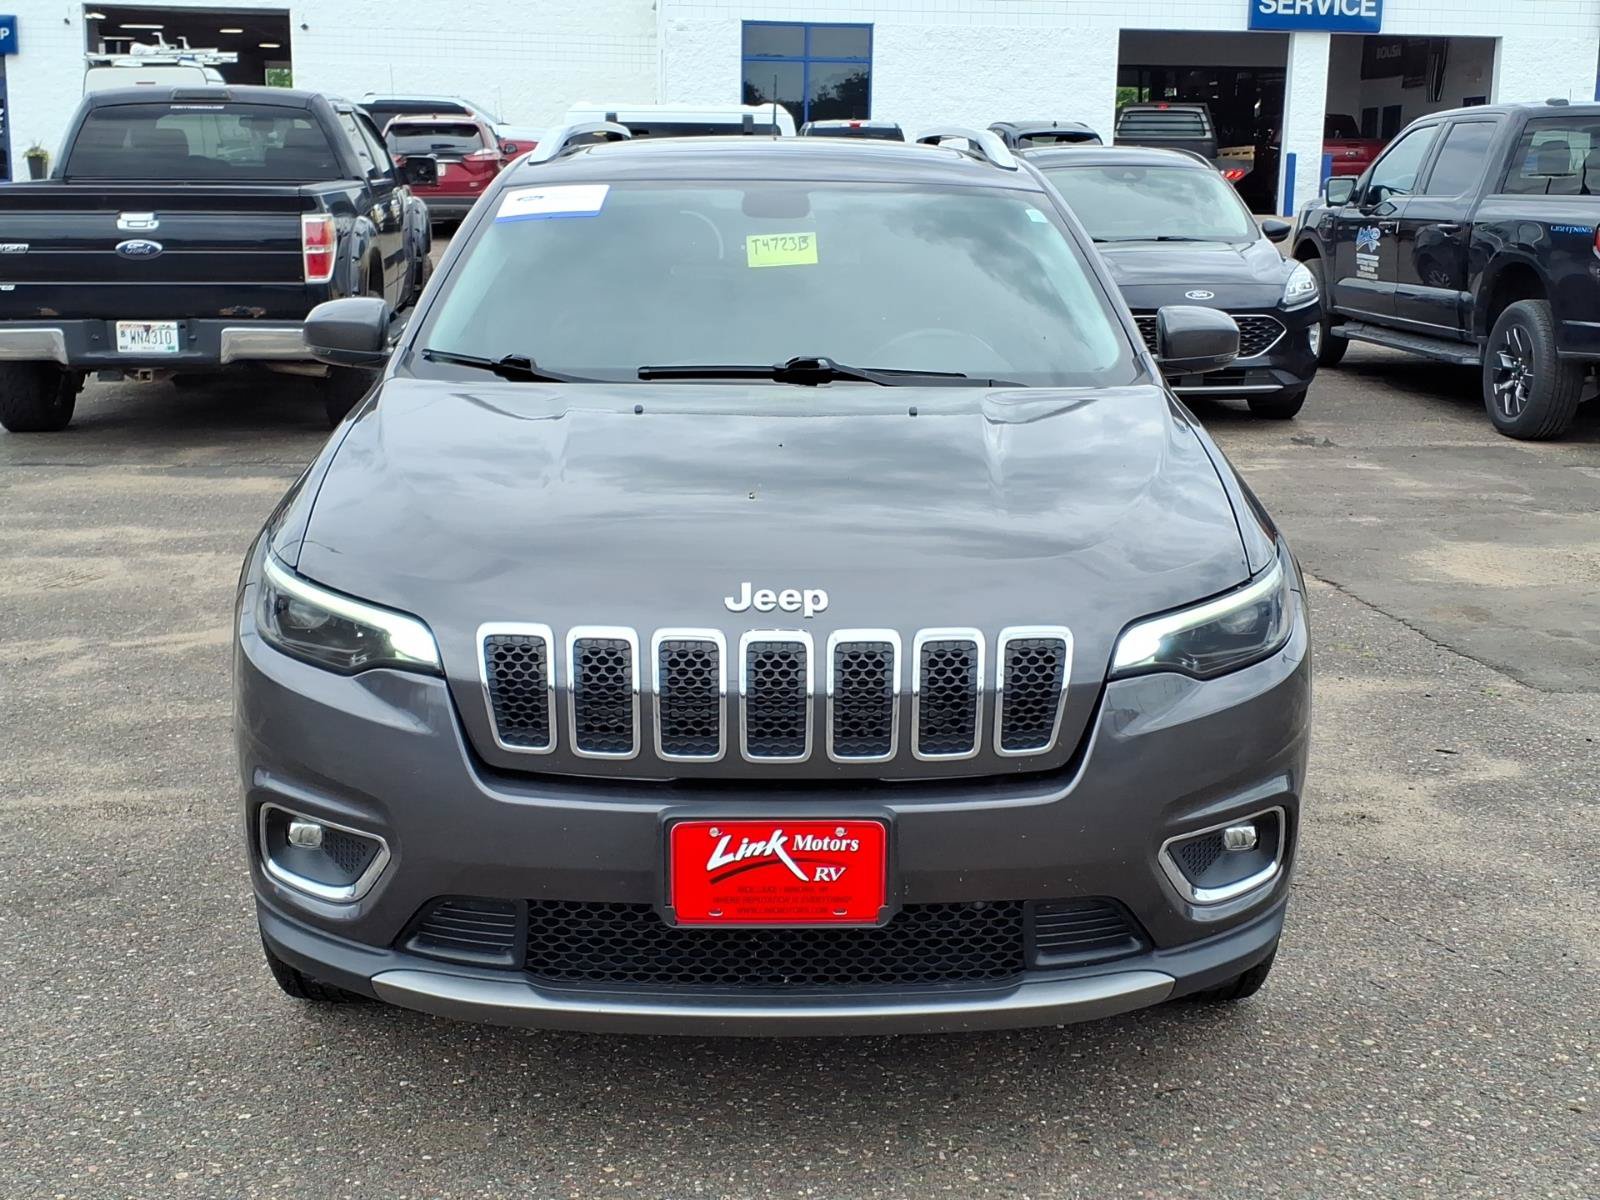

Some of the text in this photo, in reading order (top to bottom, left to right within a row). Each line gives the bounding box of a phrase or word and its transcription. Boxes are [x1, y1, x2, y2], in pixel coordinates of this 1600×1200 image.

[1258, 0, 1377, 17] SERVICE
[1550, 225, 1593, 234] LIGHTNING
[751, 235, 809, 255] T4723B
[724, 582, 829, 619] Jeep
[706, 829, 860, 882] Link Motors
[813, 866, 847, 882] RV
